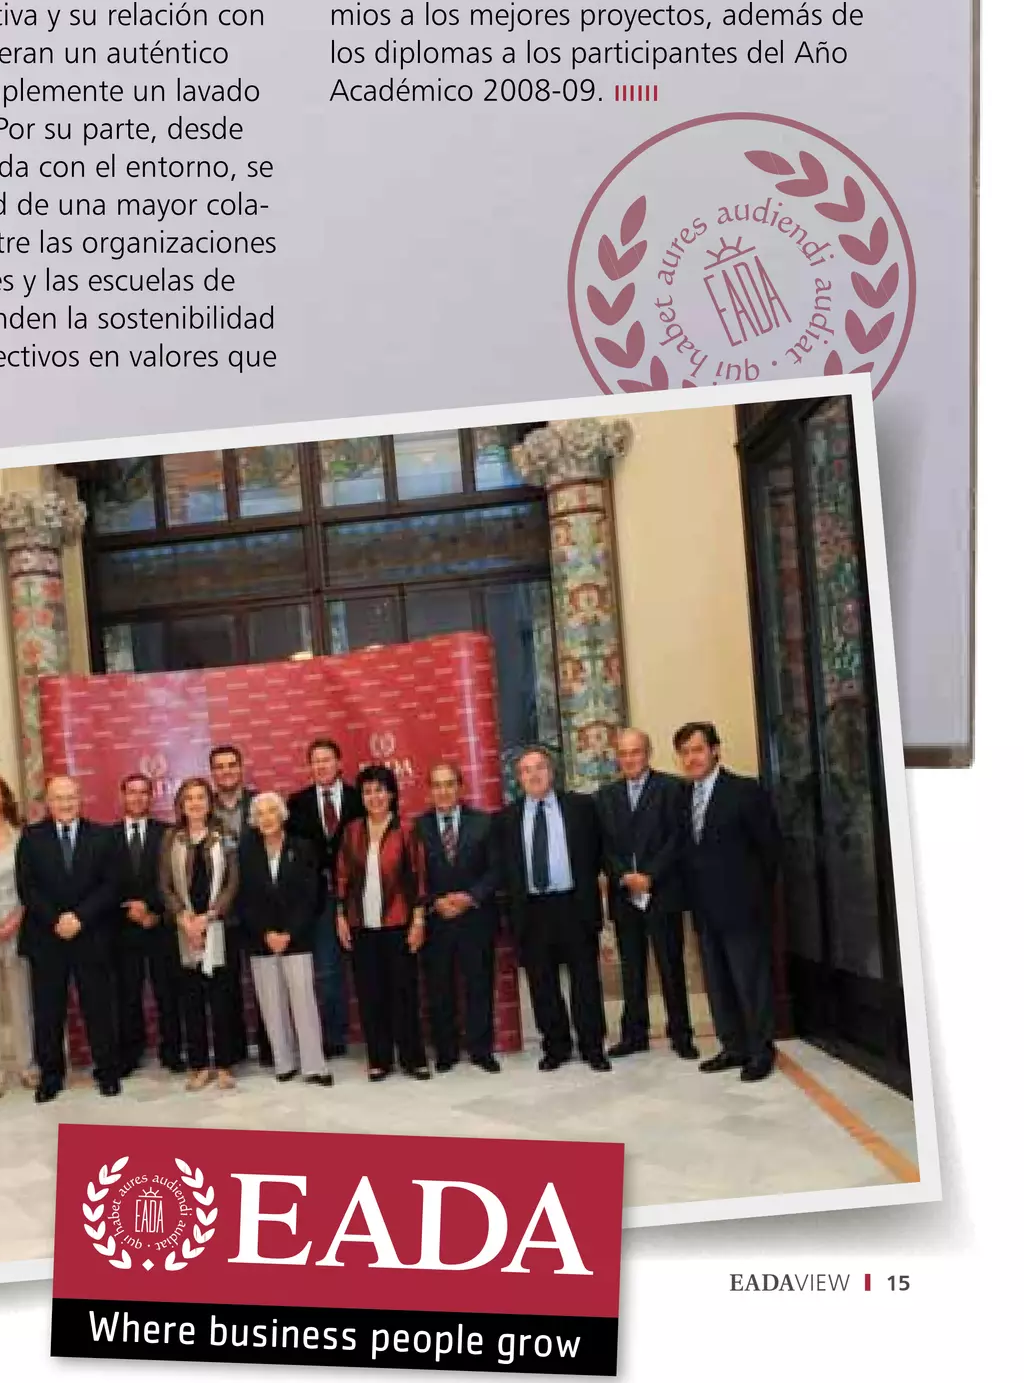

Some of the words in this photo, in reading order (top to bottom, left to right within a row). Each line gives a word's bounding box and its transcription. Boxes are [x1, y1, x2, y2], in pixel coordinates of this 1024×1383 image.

[65, 46, 97, 64] un
[106, 39, 229, 65] auténtico
[331, 39, 366, 64] los
[374, 39, 493, 71] diplomas
[502, 46, 516, 64] a
[527, 39, 562, 64] los
[571, 39, 738, 71] participantes
[746, 39, 784, 64] del
[793, 40, 848, 64] Año
[329, 77, 474, 102] Académico
[483, 78, 603, 102] 2008-09.
[39, 160, 85, 178] con
[95, 153, 116, 178] el
[126, 156, 236, 182] entorno,
[247, 160, 274, 178] se
[717, 197, 835, 267] audiendi
[657, 217, 708, 286] aures
[68, 304, 88, 330] la
[97, 304, 274, 330] sostenibilidad
[703, 255, 793, 347] EADA
[654, 294, 708, 378] habet
[784, 277, 835, 365] audiat
[712, 358, 761, 386] qui
[134, 1199, 164, 1233] EADA
[227, 1173, 594, 1276] EADA
[887, 1275, 911, 1292] 15
[88, 1310, 195, 1345] Where
[210, 1314, 357, 1351] business
[371, 1323, 483, 1363] people
[497, 1333, 581, 1365] grow
